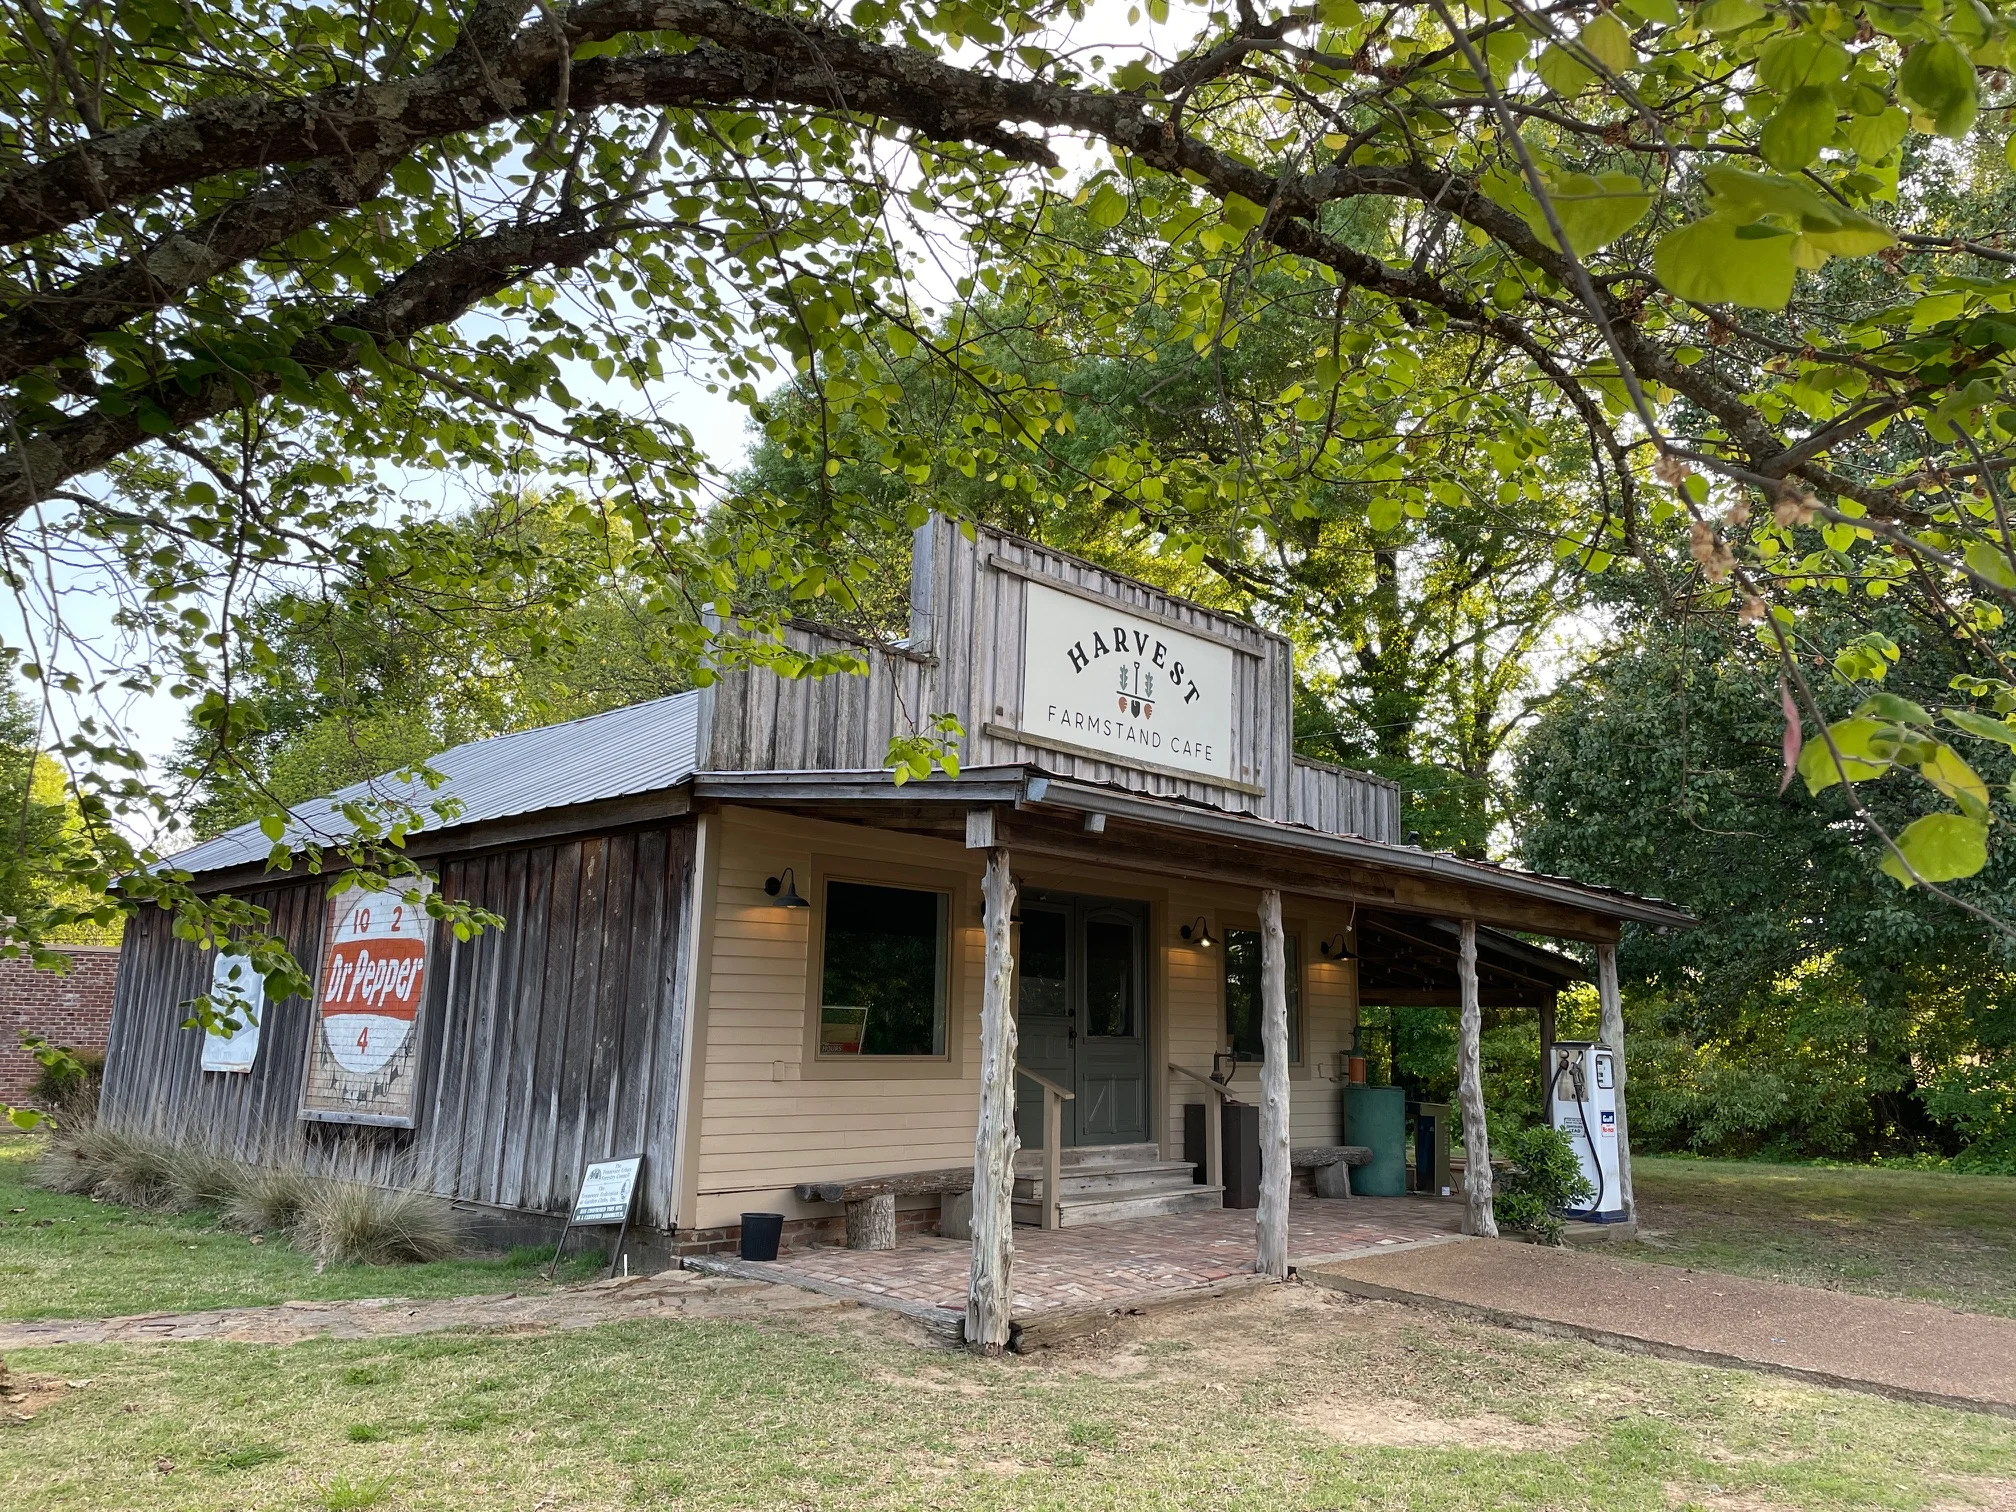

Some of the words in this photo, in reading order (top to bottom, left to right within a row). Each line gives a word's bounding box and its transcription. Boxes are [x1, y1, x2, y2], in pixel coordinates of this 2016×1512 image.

[1066, 626, 1201, 704] HARVEST
[1047, 704, 1162, 748] FARMSTAND
[1170, 736, 1213, 762] CAFE
[353, 908, 371, 934] 10
[391, 906, 403, 932] 2
[325, 953, 353, 1003] Dr
[346, 949, 424, 1007] Pepper
[356, 1026, 369, 1054] 4
